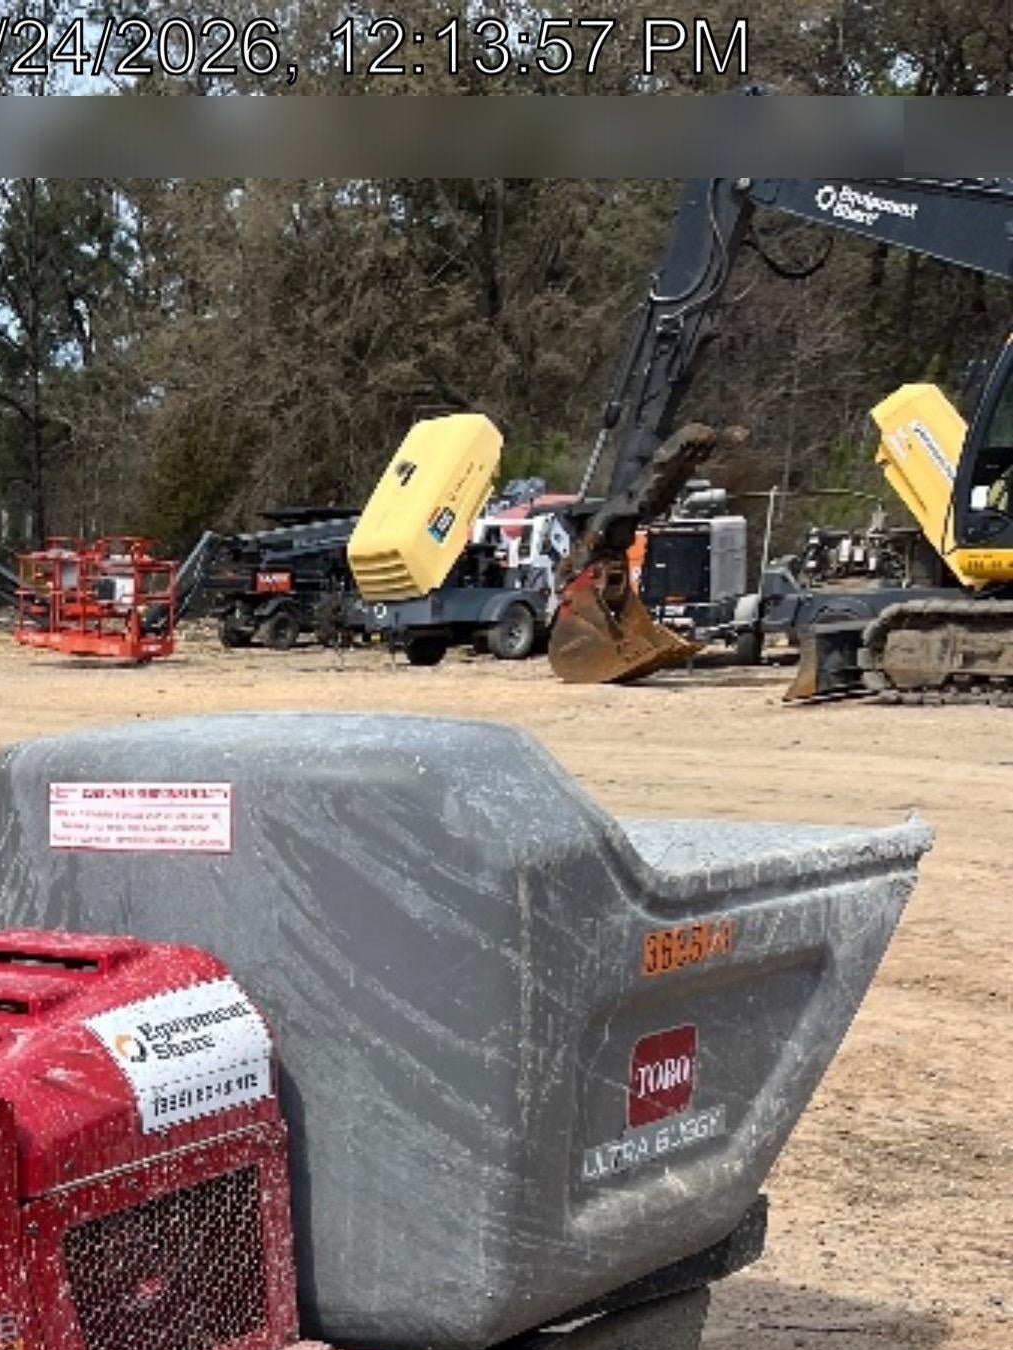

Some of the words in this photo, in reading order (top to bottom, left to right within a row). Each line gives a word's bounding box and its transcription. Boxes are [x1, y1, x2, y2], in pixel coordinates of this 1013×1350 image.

[839, 186, 918, 219] Equipment
[137, 1001, 252, 1042] Equipment
[151, 1034, 216, 1060] Share
[638, 1055, 690, 1099] TORO
